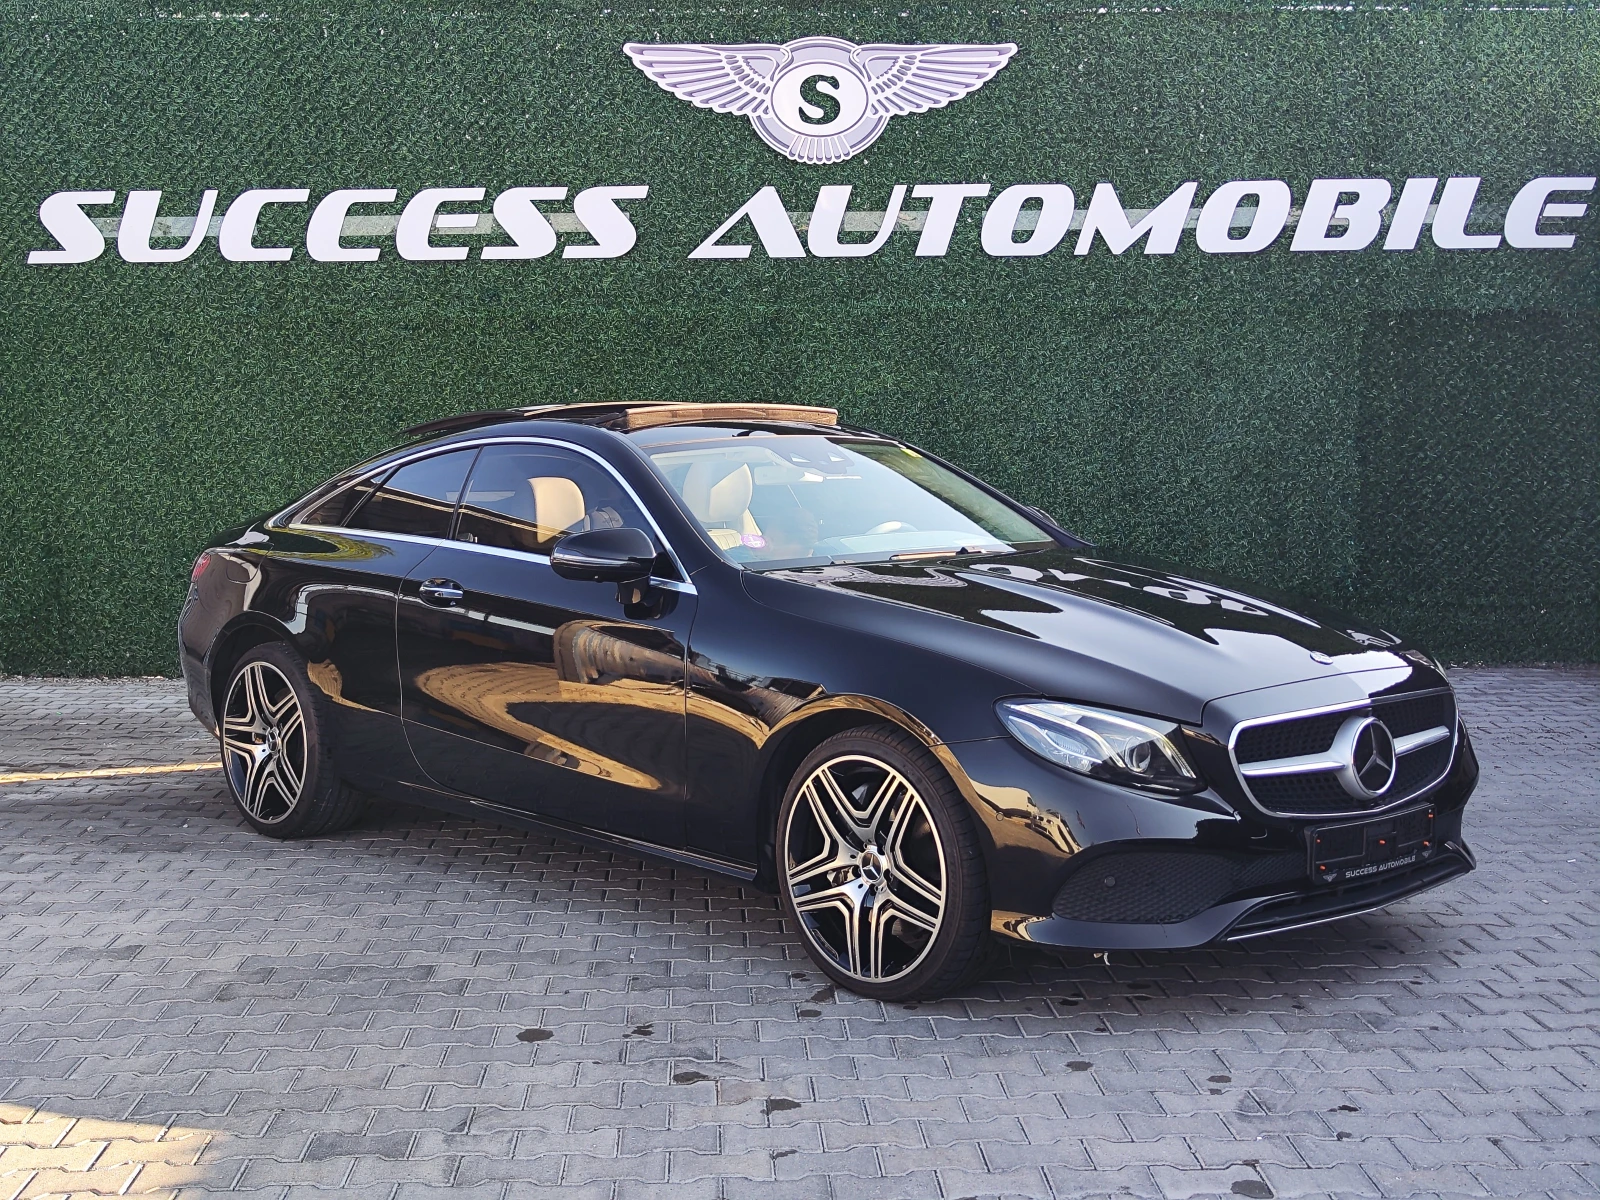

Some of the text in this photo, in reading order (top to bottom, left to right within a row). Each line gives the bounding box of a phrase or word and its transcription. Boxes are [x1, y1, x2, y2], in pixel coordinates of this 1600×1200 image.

[798, 74, 841, 125] S
[27, 176, 1597, 265] SUCCESS AUTOMOBILE
[1345, 855, 1416, 879] SUCCESS AUTOMOBILE
